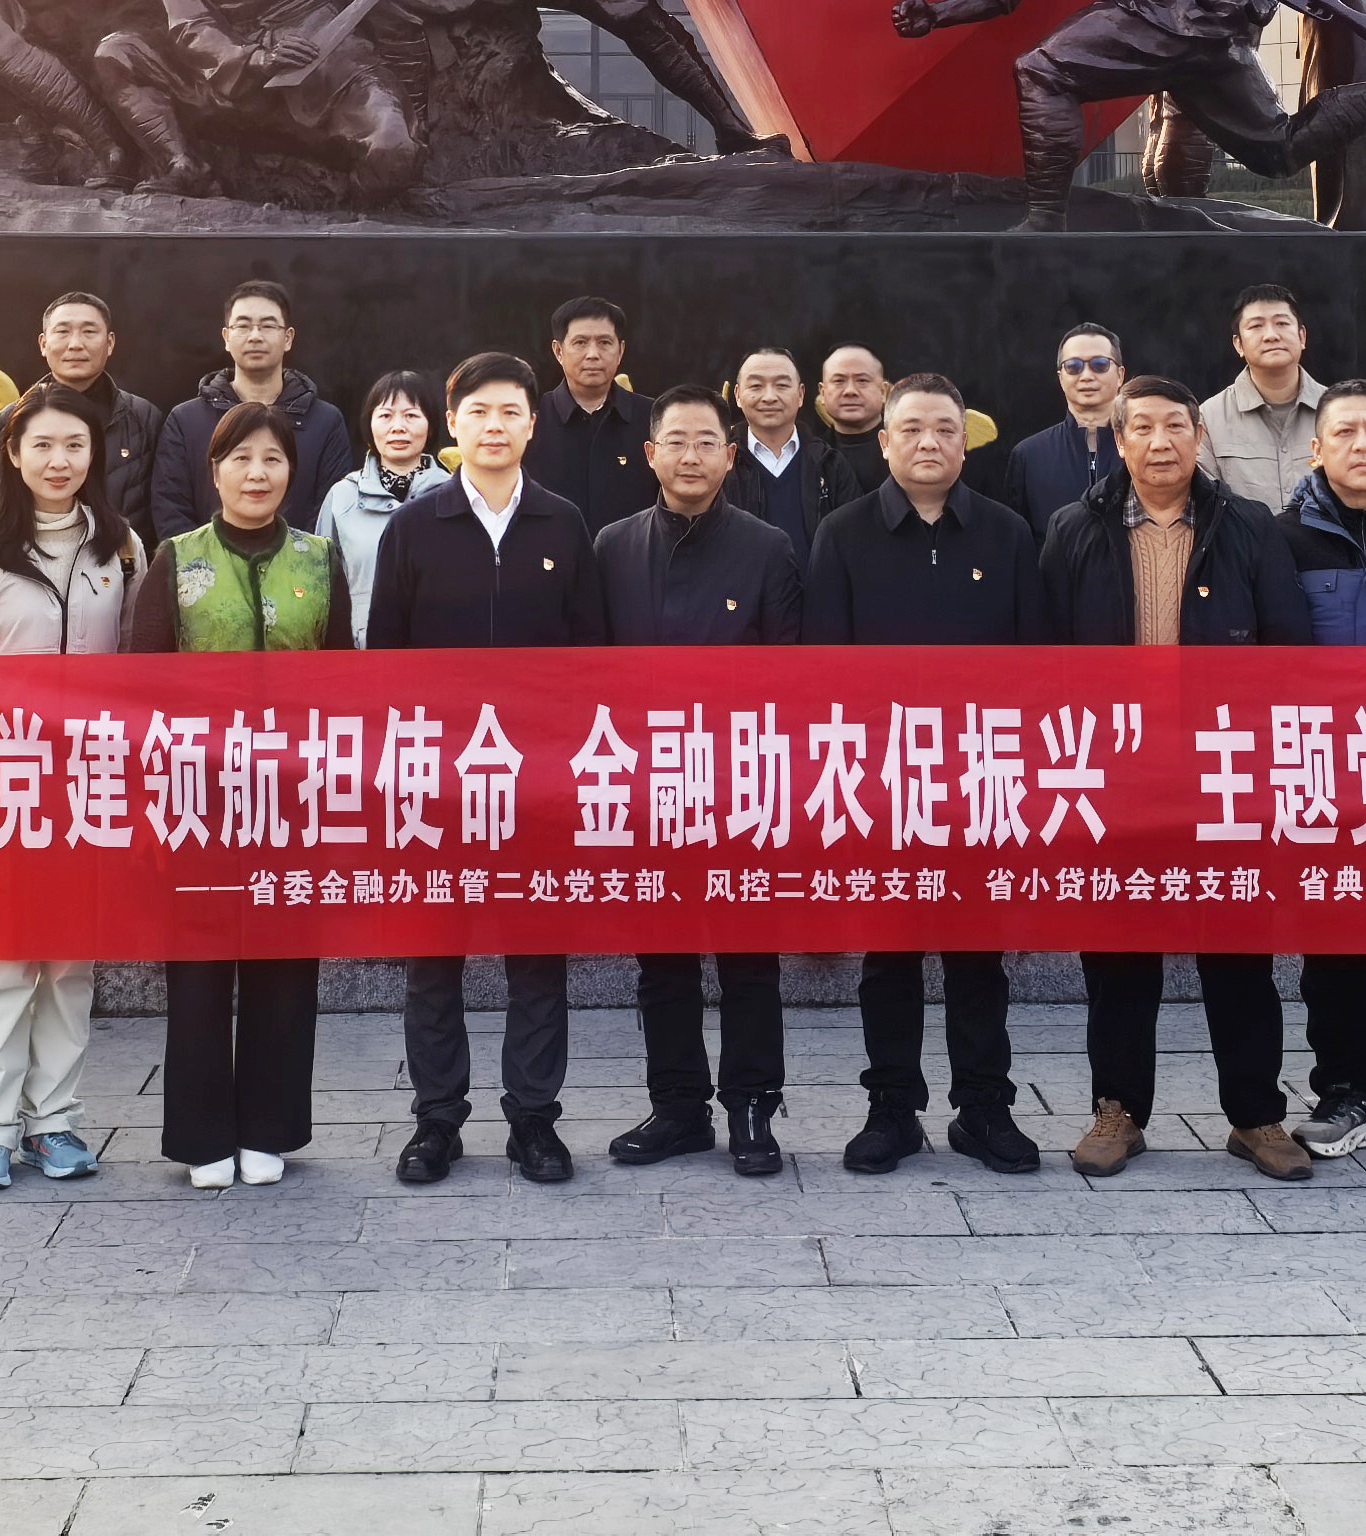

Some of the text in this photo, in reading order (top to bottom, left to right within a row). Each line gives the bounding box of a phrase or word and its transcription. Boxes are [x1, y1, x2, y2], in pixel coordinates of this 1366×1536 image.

[567, 700, 1143, 852] 金融助农促振兴”
